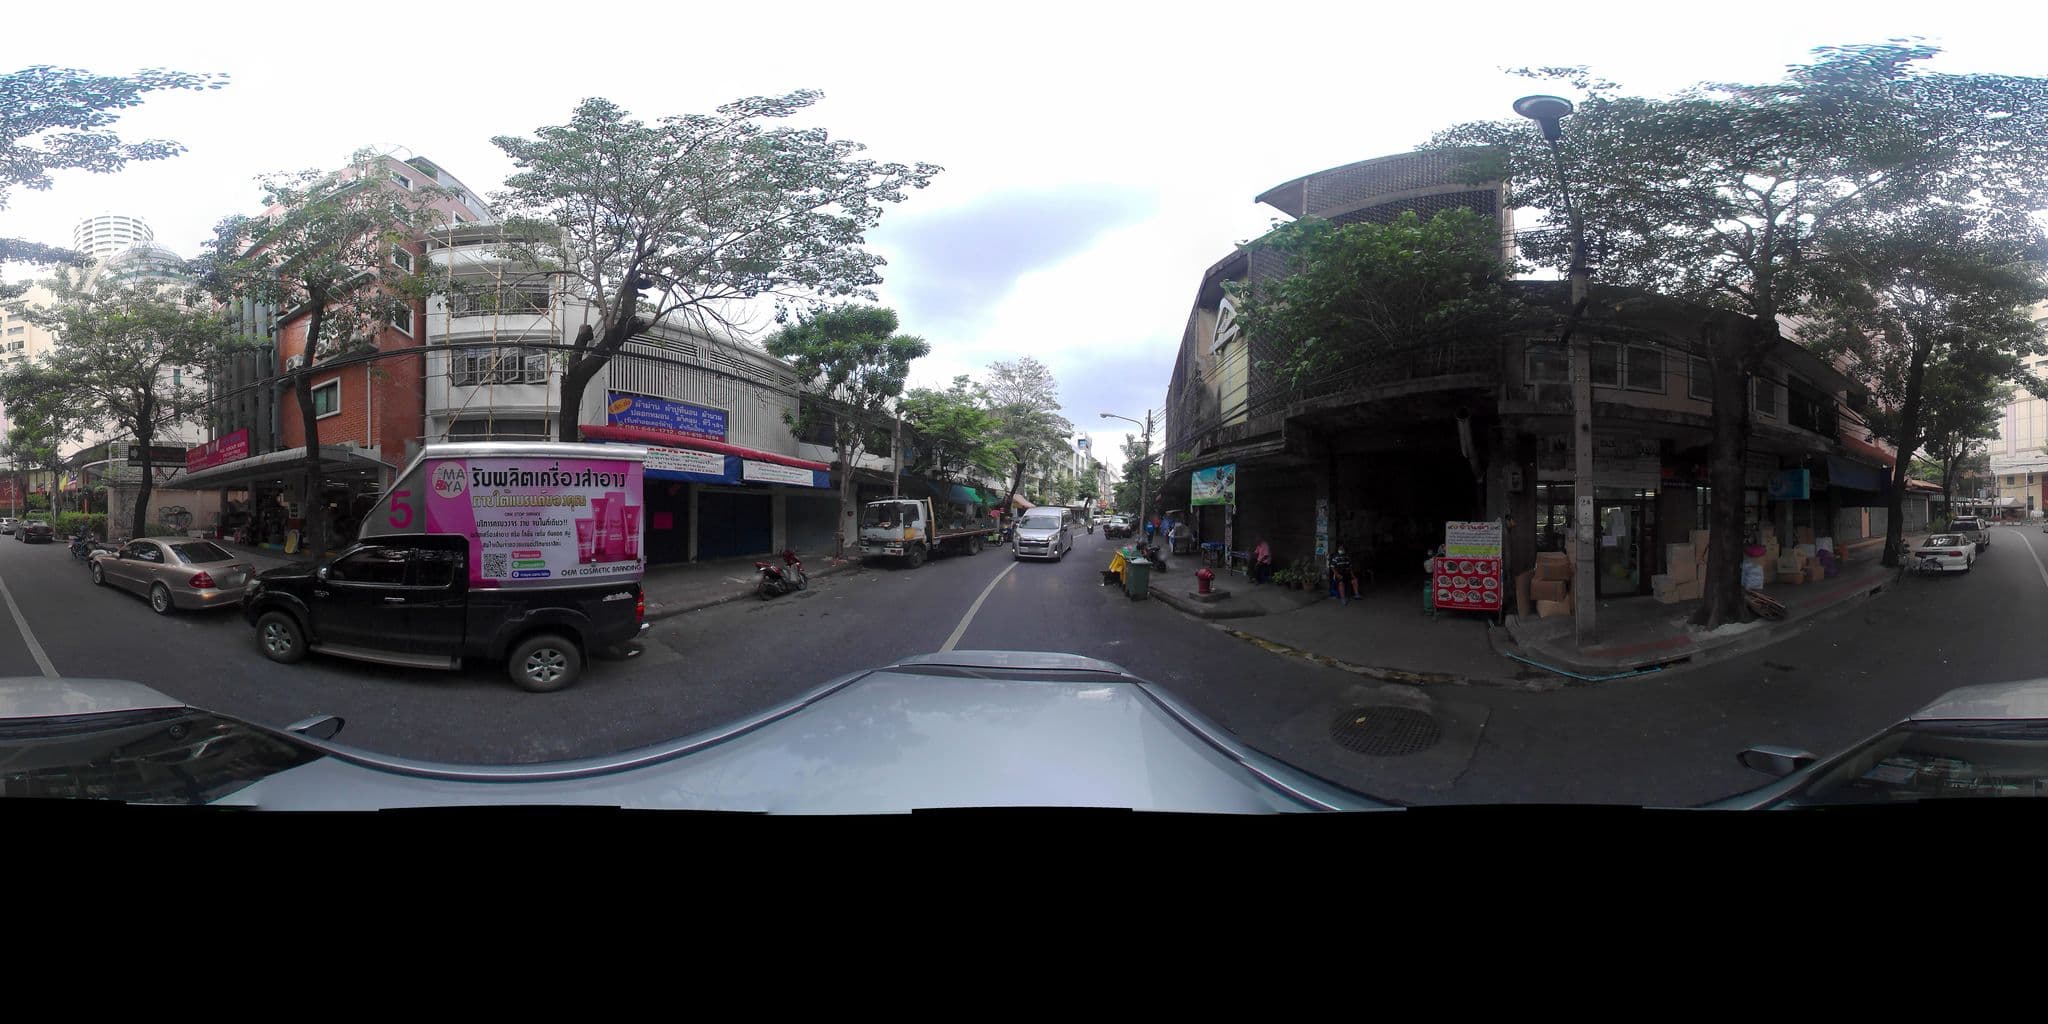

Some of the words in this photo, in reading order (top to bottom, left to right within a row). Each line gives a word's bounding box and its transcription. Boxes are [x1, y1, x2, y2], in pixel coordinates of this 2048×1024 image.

[443, 468, 466, 480] MA
[472, 462, 625, 488] รับผลิตเครื่องสำอาง
[445, 481, 463, 492] YA
[388, 490, 414, 529] 5
[579, 566, 610, 576] COSMETIC
